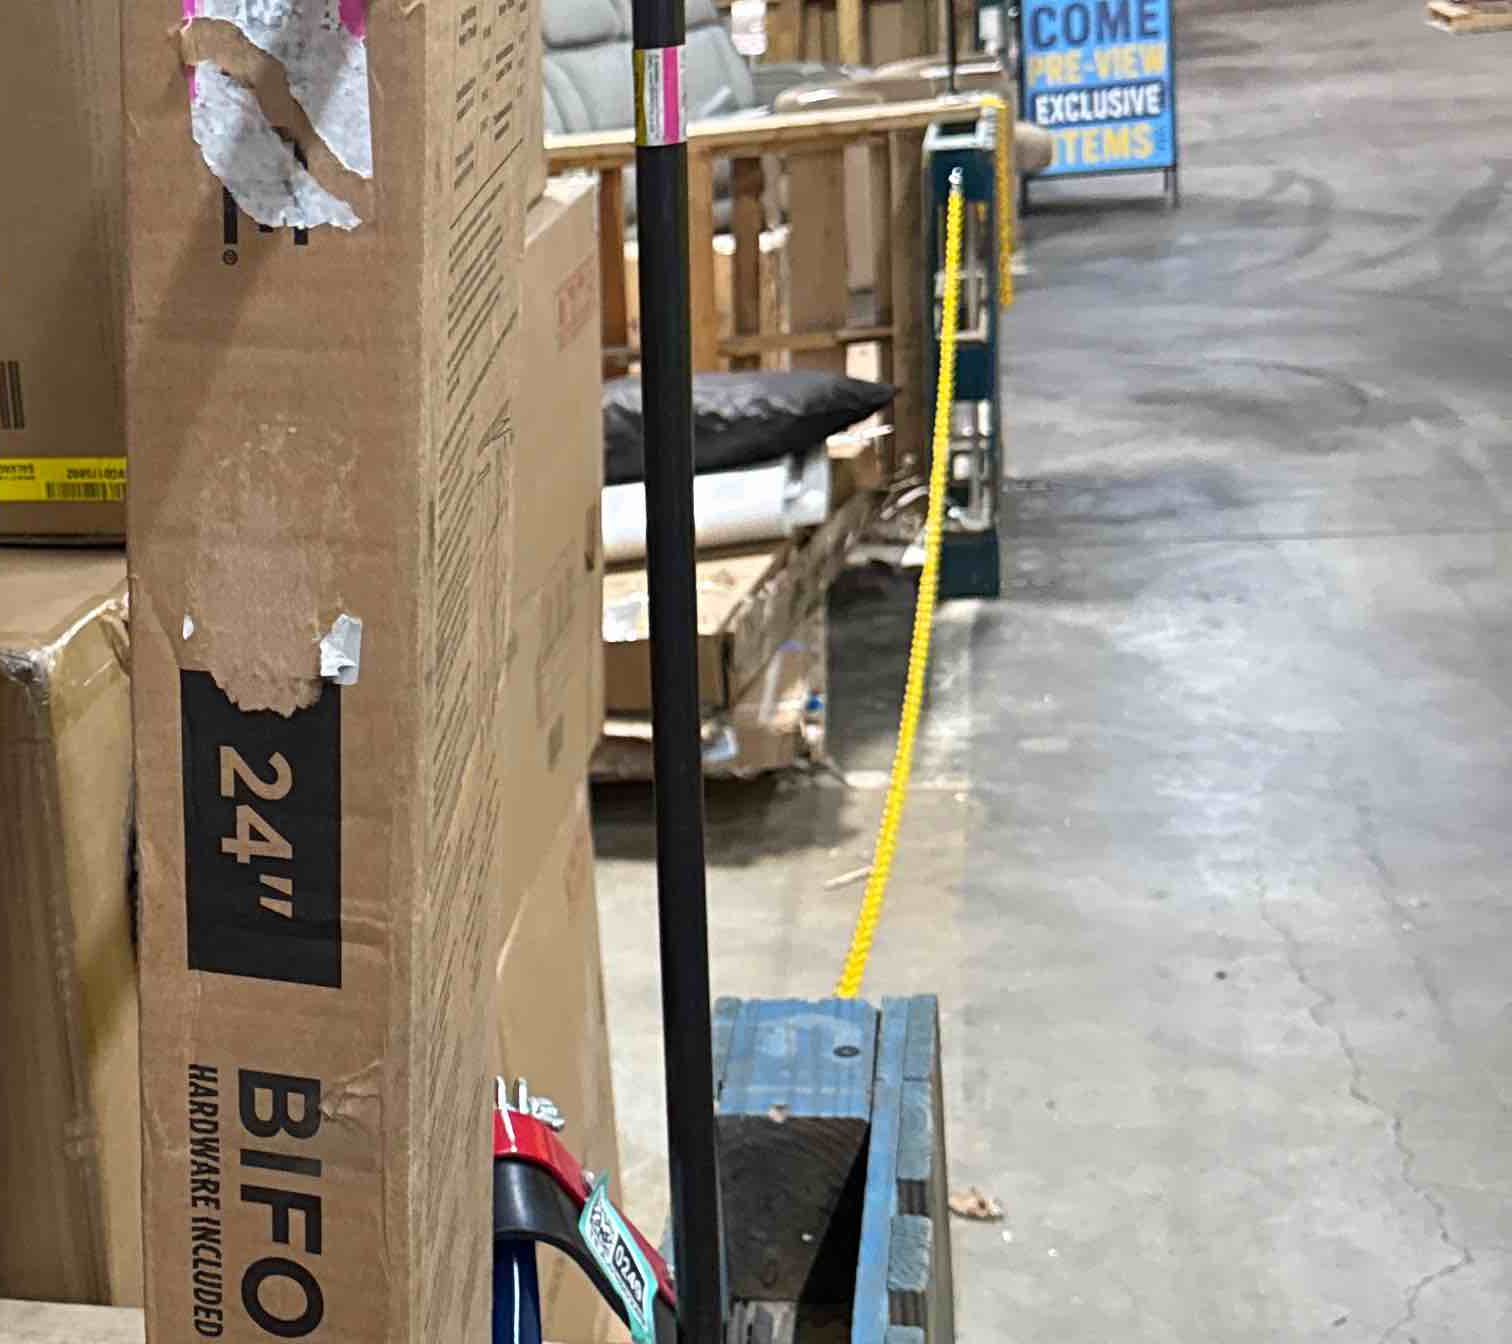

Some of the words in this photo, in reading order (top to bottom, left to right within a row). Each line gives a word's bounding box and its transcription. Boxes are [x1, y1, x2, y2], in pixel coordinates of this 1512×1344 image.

[1027, 41, 1168, 86] PRE-VIEW
[1035, 83, 1162, 125] EXCLUSIVE
[188, 1063, 221, 1211] HARDWARE
[191, 1215, 224, 1339] INCLUDED
